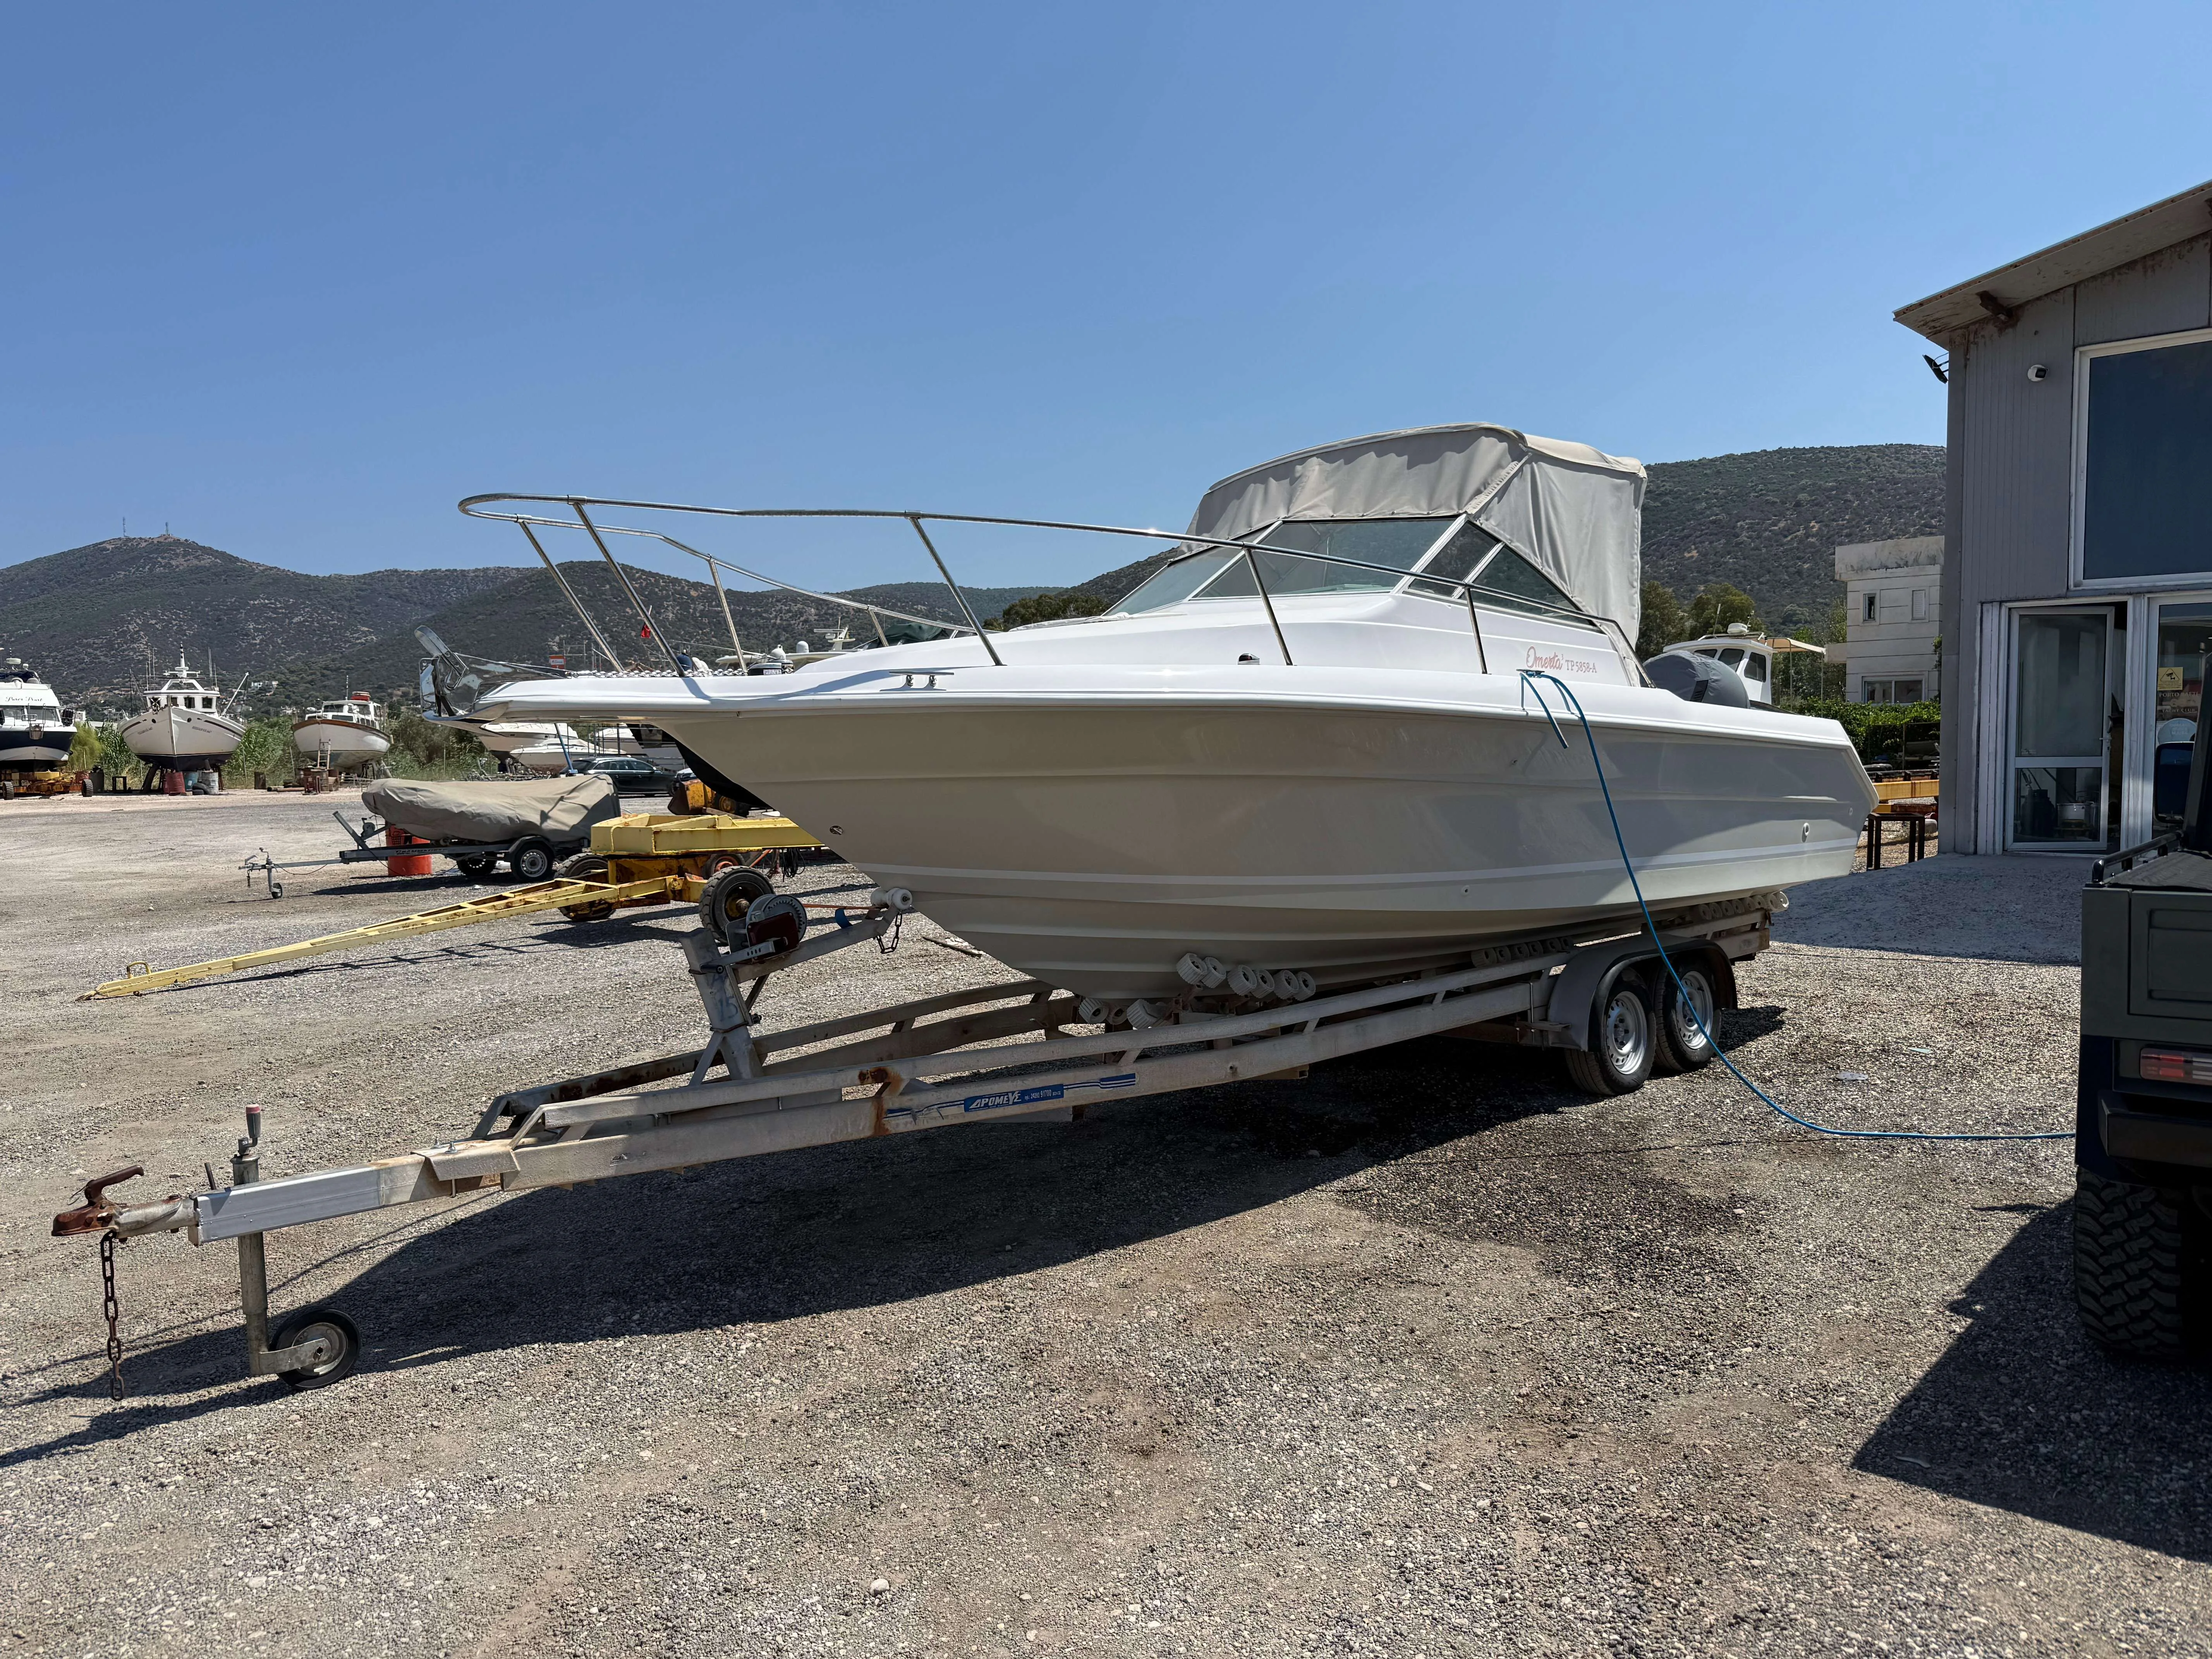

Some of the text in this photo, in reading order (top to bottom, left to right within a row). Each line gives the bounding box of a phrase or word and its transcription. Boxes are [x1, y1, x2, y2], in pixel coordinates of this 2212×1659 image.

[1565, 659, 1575, 671] TP
[1576, 661, 1597, 673] 5858-A
[1041, 1089, 1052, 1098] 91700
